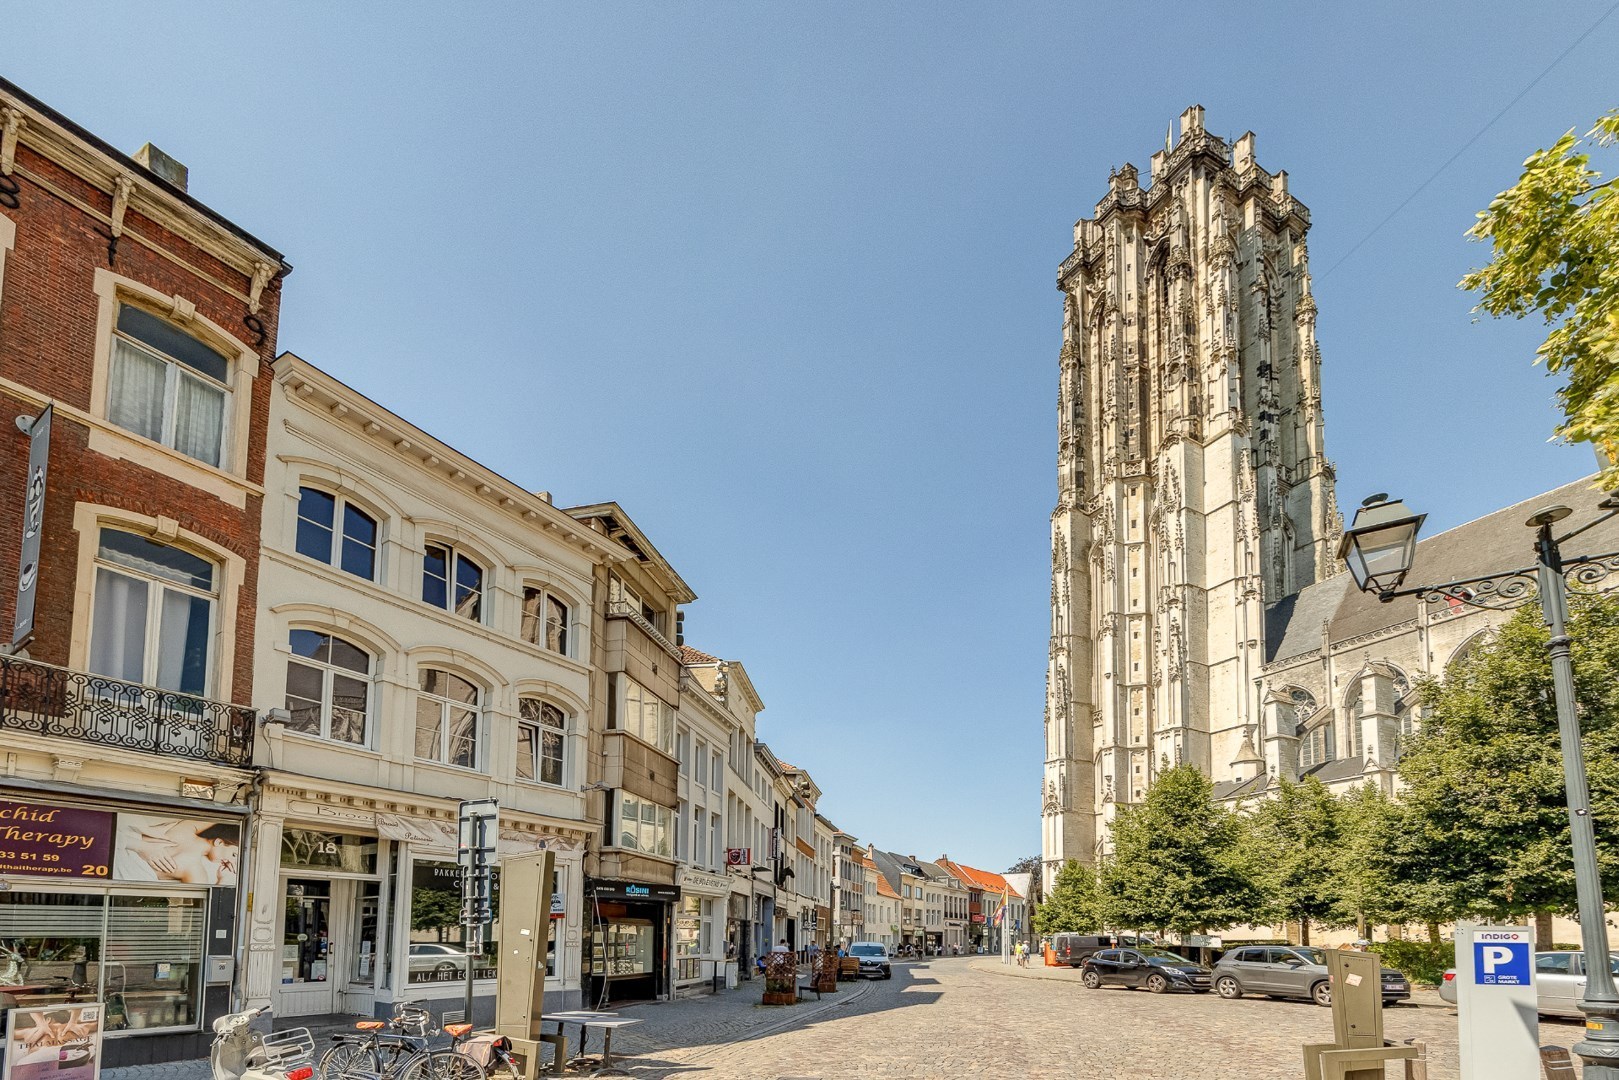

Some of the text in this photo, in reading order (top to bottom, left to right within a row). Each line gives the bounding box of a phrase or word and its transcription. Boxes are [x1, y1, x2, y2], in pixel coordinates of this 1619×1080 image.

[0, 807, 60, 823] chid
[317, 842, 337, 854] 18
[20, 852, 37, 860] 51
[81, 864, 108, 876] 20
[1482, 946, 1513, 974] P
[416, 972, 432, 982] ALS
[437, 971, 453, 981] HET
[18, 1035, 93, 1049] THAI MASSAGE
